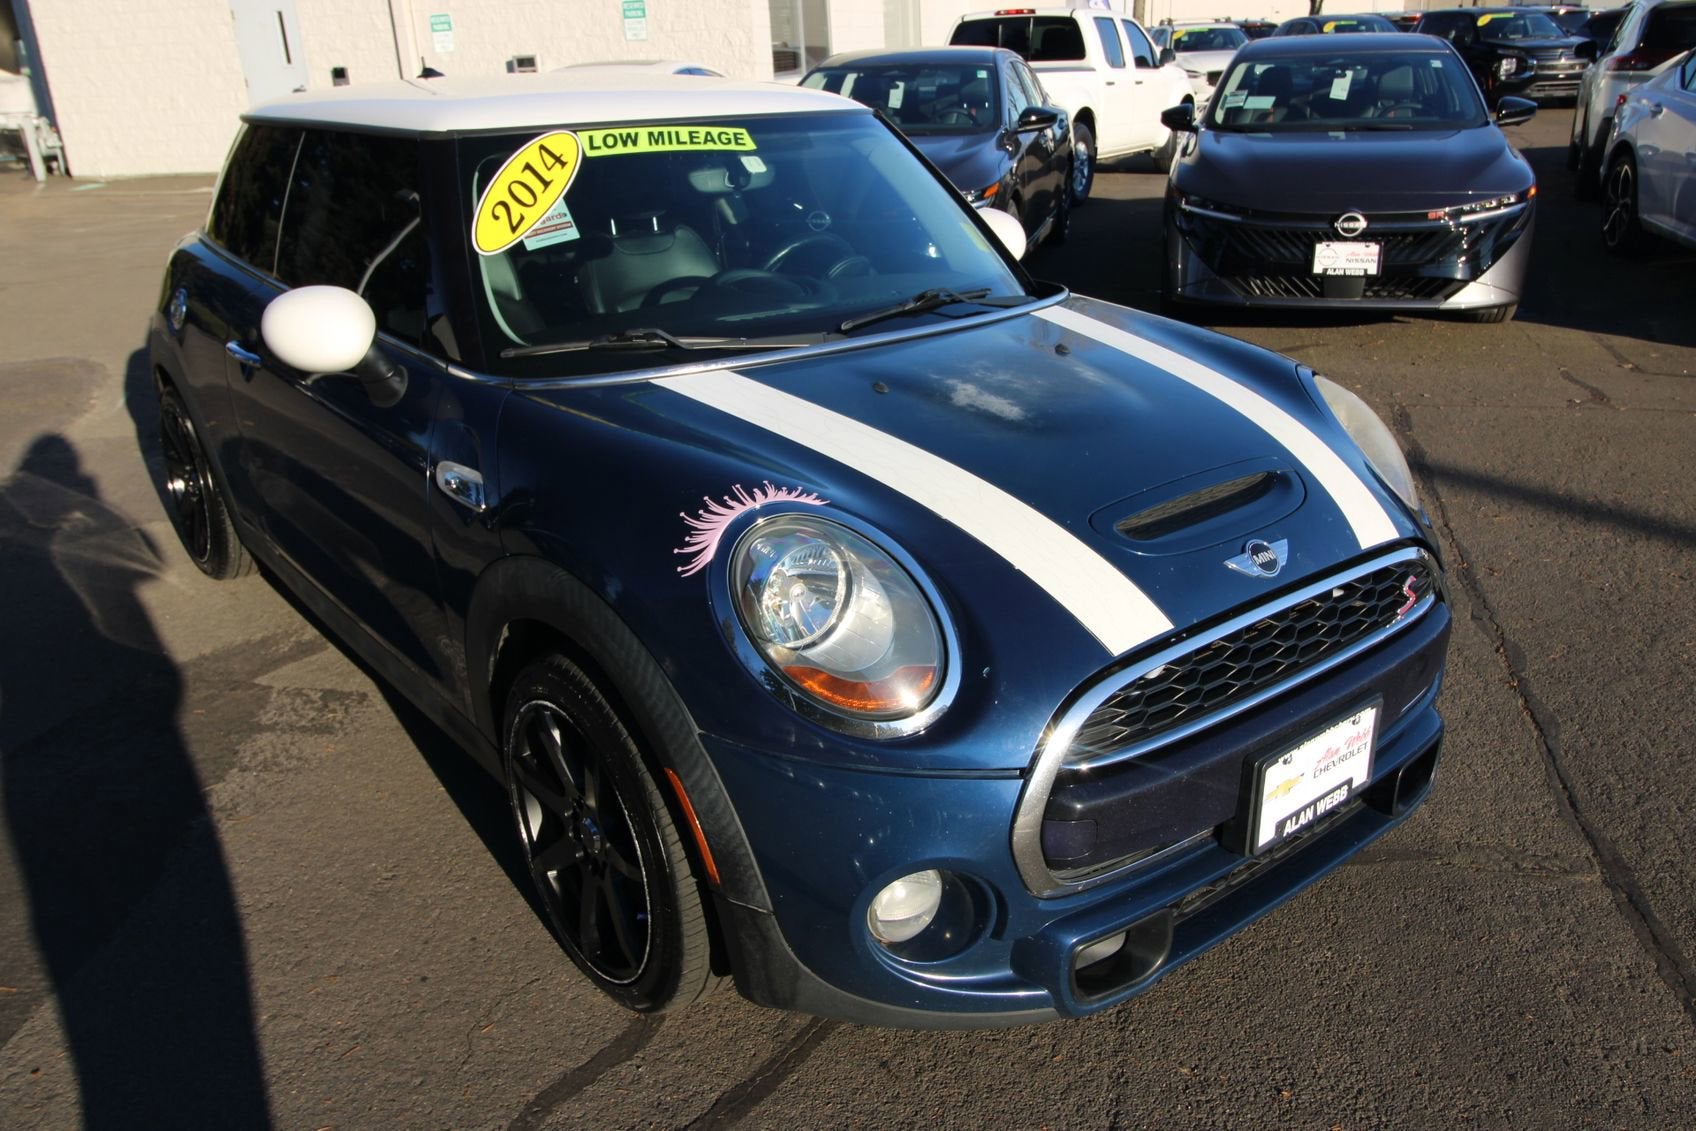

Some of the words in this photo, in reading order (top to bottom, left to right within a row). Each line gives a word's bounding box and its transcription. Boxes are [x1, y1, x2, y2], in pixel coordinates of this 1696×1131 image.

[588, 131, 639, 150] LOW
[648, 130, 747, 146] MILEAGE
[491, 143, 568, 235] 2014
[1253, 550, 1276, 565] MINI
[1313, 741, 1368, 779] CHEVROLET
[1283, 804, 1315, 837] ALAN
[1316, 784, 1349, 816] WEBB
